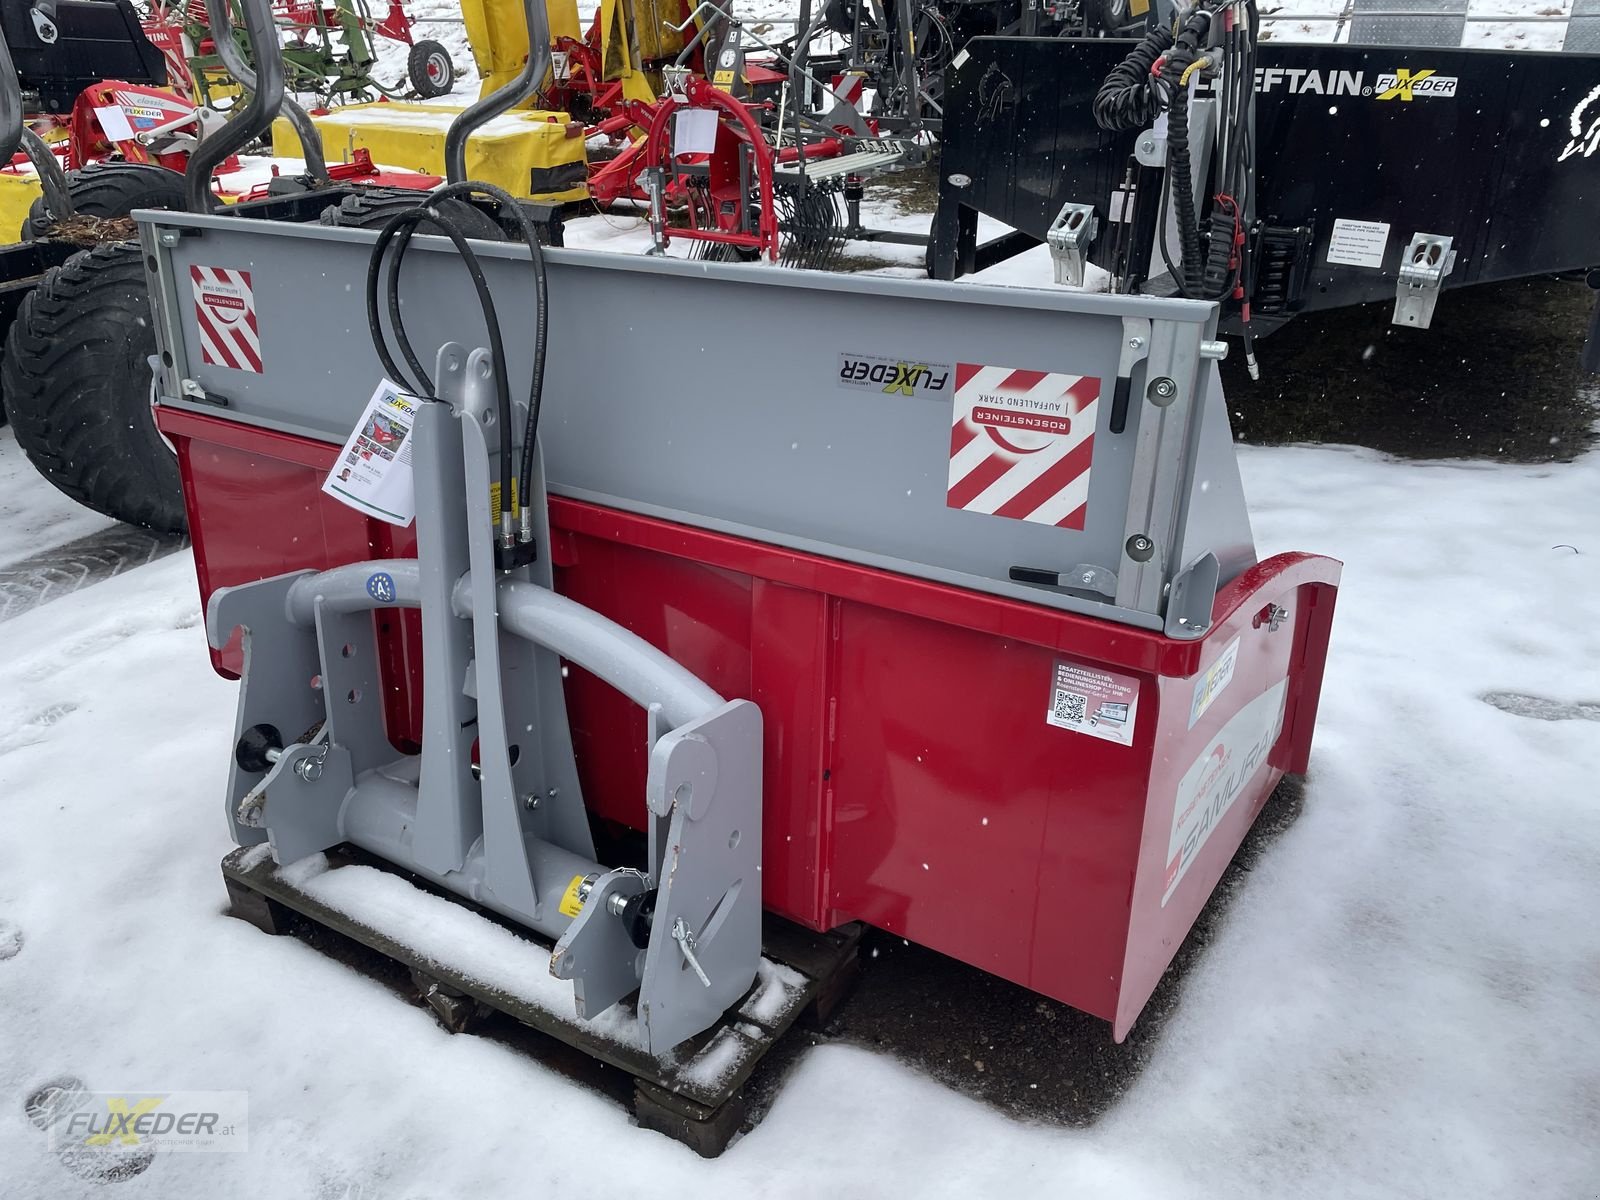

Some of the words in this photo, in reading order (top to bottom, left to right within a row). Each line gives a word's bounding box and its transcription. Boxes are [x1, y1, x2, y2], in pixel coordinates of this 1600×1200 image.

[1377, 76, 1456, 93] FLIXEDER
[136, 96, 165, 108] classic
[124, 106, 162, 118] FLIXEDER
[840, 360, 949, 391] FLIXEDER
[385, 395, 417, 416] FLIXEDE
[978, 394, 1004, 405] STARK
[1007, 396, 1061, 411] AUFFALLEND
[976, 411, 1067, 430] ROSENSTEINER
[377, 581, 387, 595] A
[1057, 670, 1132, 693] BEDIENUNGSANLEITUNG
[1063, 677, 1102, 691] ONLINESHOP
